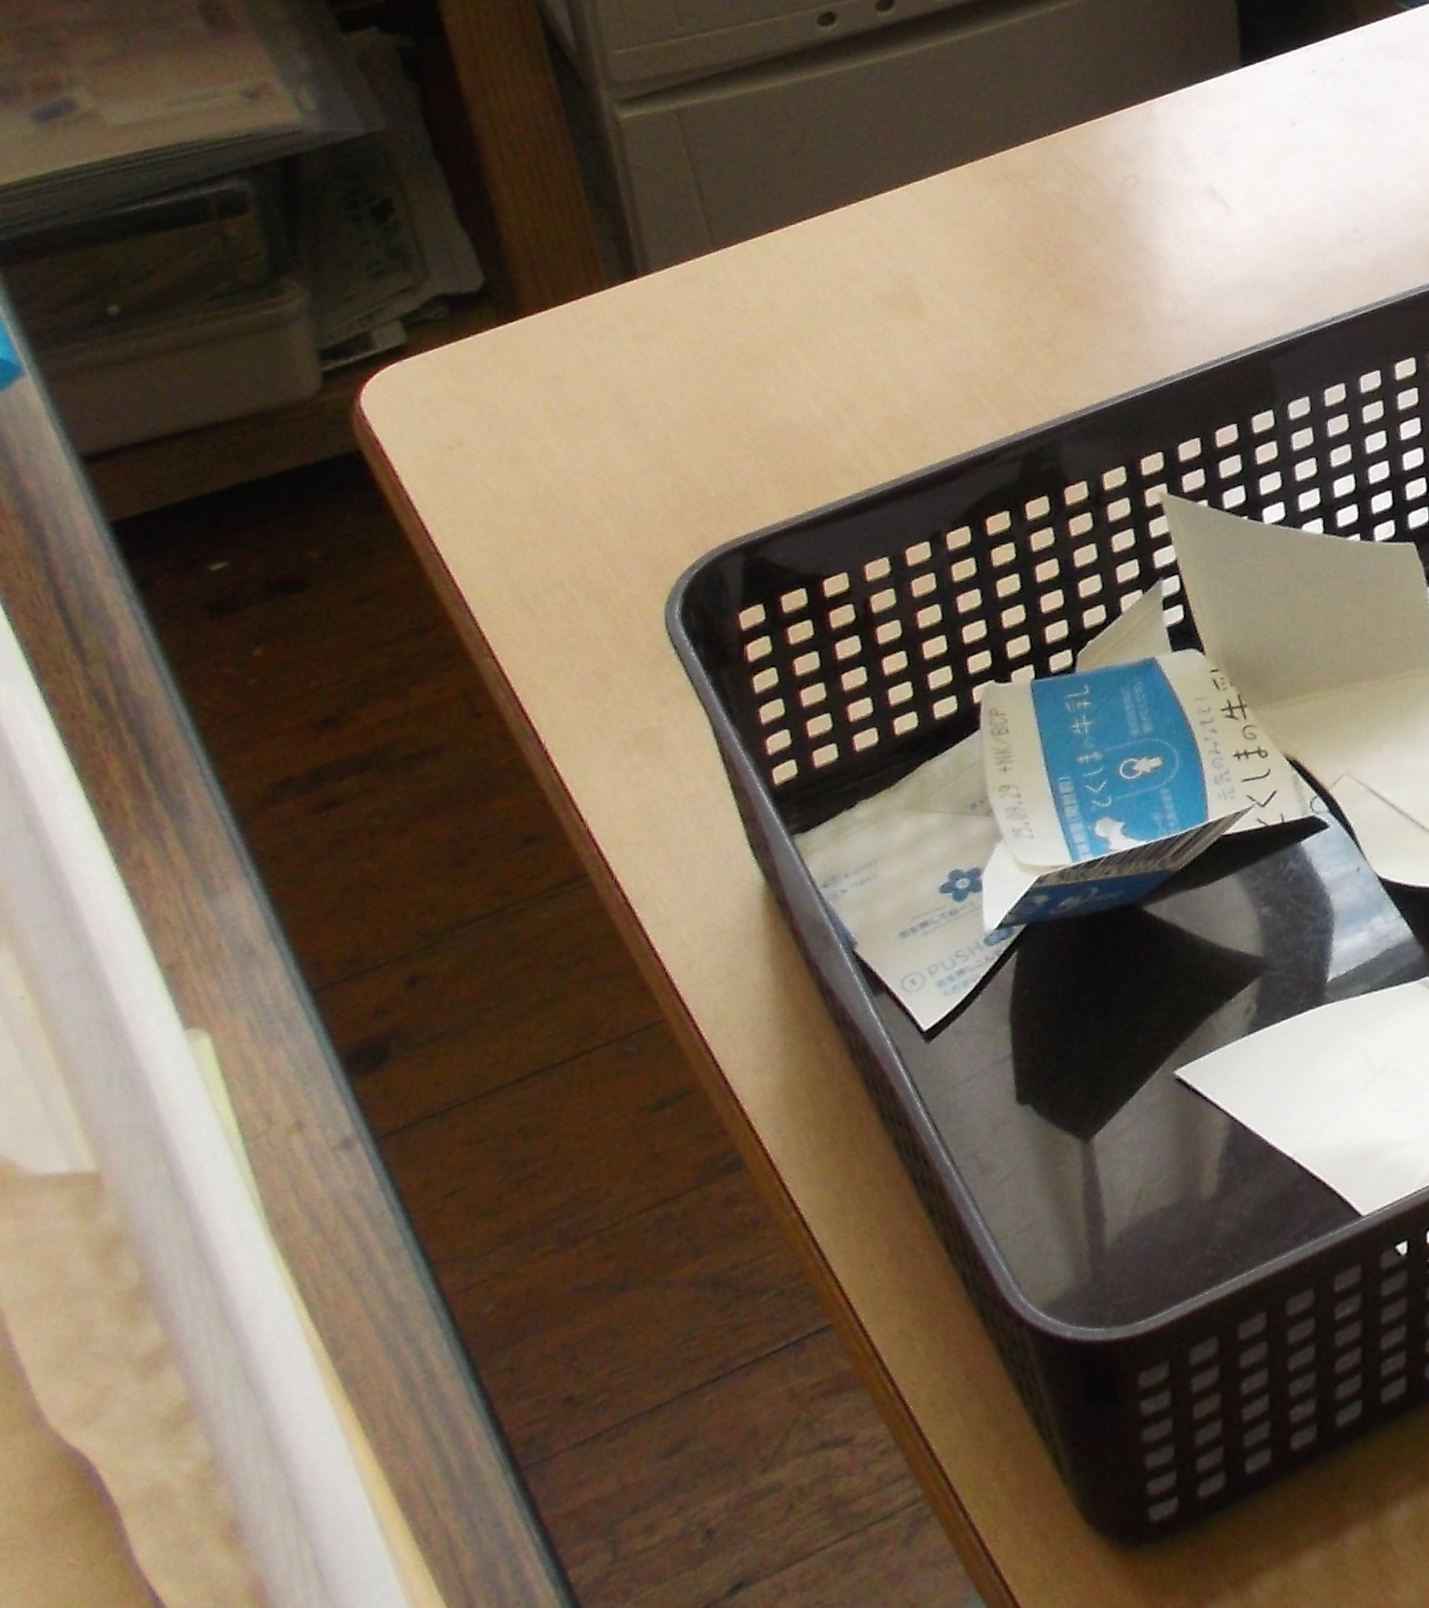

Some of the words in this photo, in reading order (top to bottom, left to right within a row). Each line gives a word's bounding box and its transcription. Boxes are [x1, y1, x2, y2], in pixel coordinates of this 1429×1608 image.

[1064, 684, 1113, 810] とくしまの牛乳
[926, 941, 983, 978] PUSH
